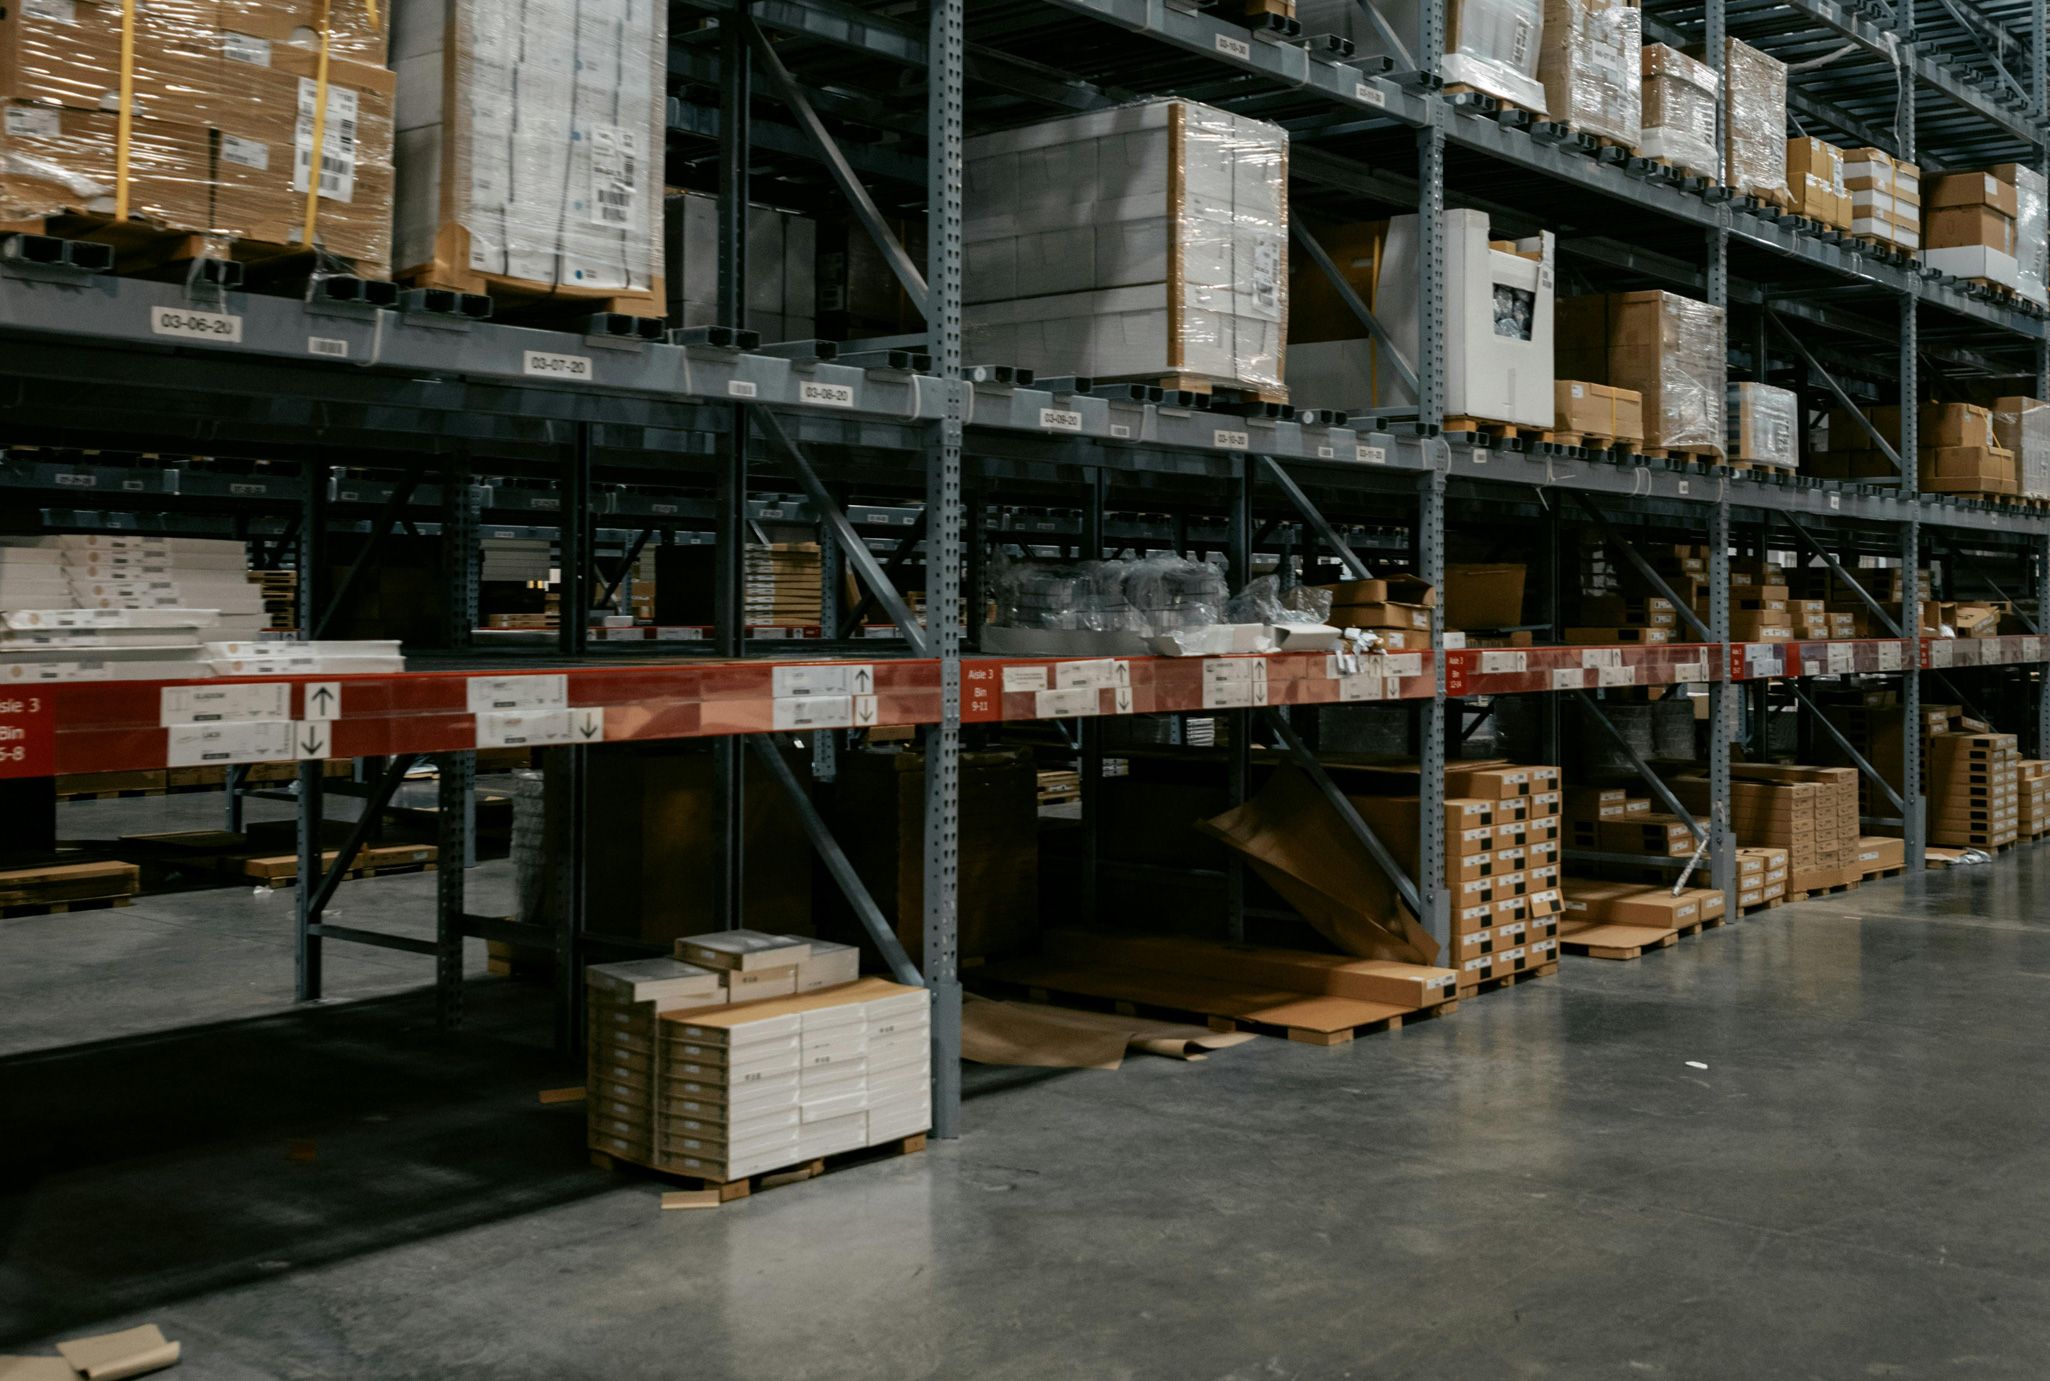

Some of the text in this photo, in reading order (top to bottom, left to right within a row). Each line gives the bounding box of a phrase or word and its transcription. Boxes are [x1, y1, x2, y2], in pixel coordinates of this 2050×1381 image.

[160, 314, 233, 334] 03-06-20
[532, 357, 585, 374] 03-07-20
[968, 669, 994, 680] Aisle 3
[974, 687, 987, 697] Bin
[29, 697, 41, 712] 3
[971, 701, 988, 711] 9-11
